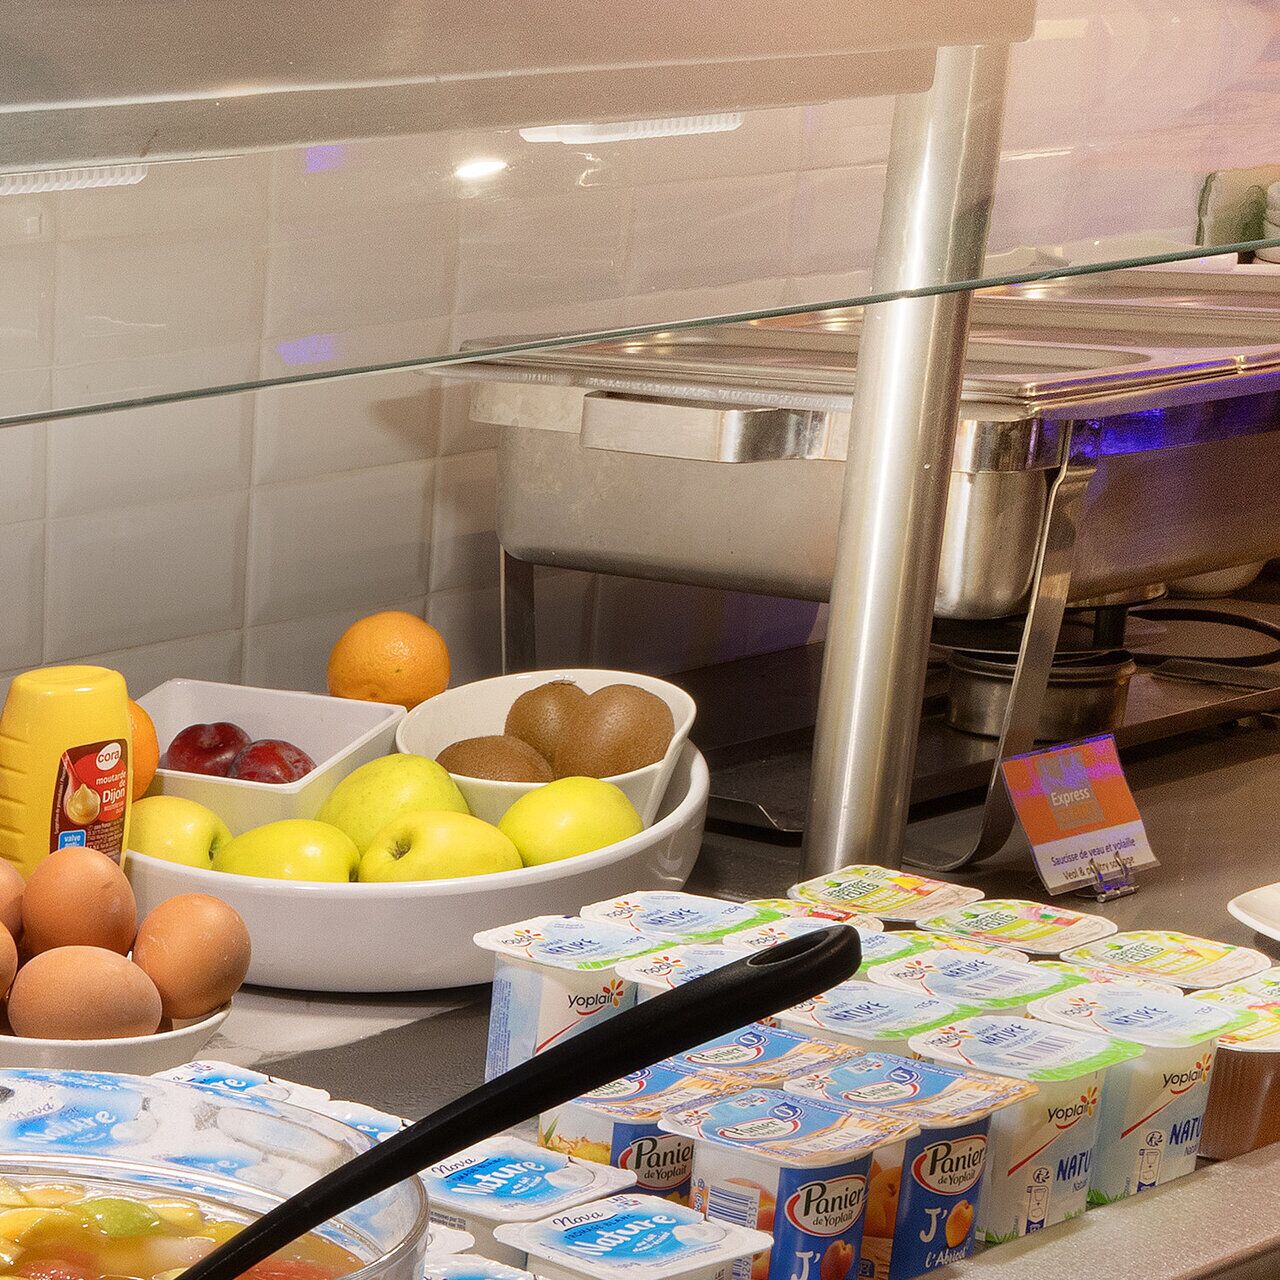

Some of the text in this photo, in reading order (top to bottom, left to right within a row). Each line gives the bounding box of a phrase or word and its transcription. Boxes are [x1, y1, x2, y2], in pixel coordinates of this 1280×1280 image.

[97, 750, 120, 763] cora
[96, 770, 127, 785] moutarde
[119, 779, 126, 788] de
[102, 787, 125, 804] Dijon
[1050, 787, 1090, 807] Express
[1051, 852, 1079, 866] Saucisse
[1079, 849, 1089, 860] de
[1063, 867, 1080, 880] Veal
[431, 1157, 477, 1175] Nova
[926, 1142, 985, 1176] Panier
[451, 1161, 545, 1196] Nature
[644, 1165, 688, 1181] de Yoplait
[938, 1170, 976, 1186] de Yoplait
[800, 1182, 864, 1217] Panier
[552, 1210, 604, 1228] Nova
[812, 1210, 854, 1227] de Yoplait
[567, 1214, 677, 1256] Nature
